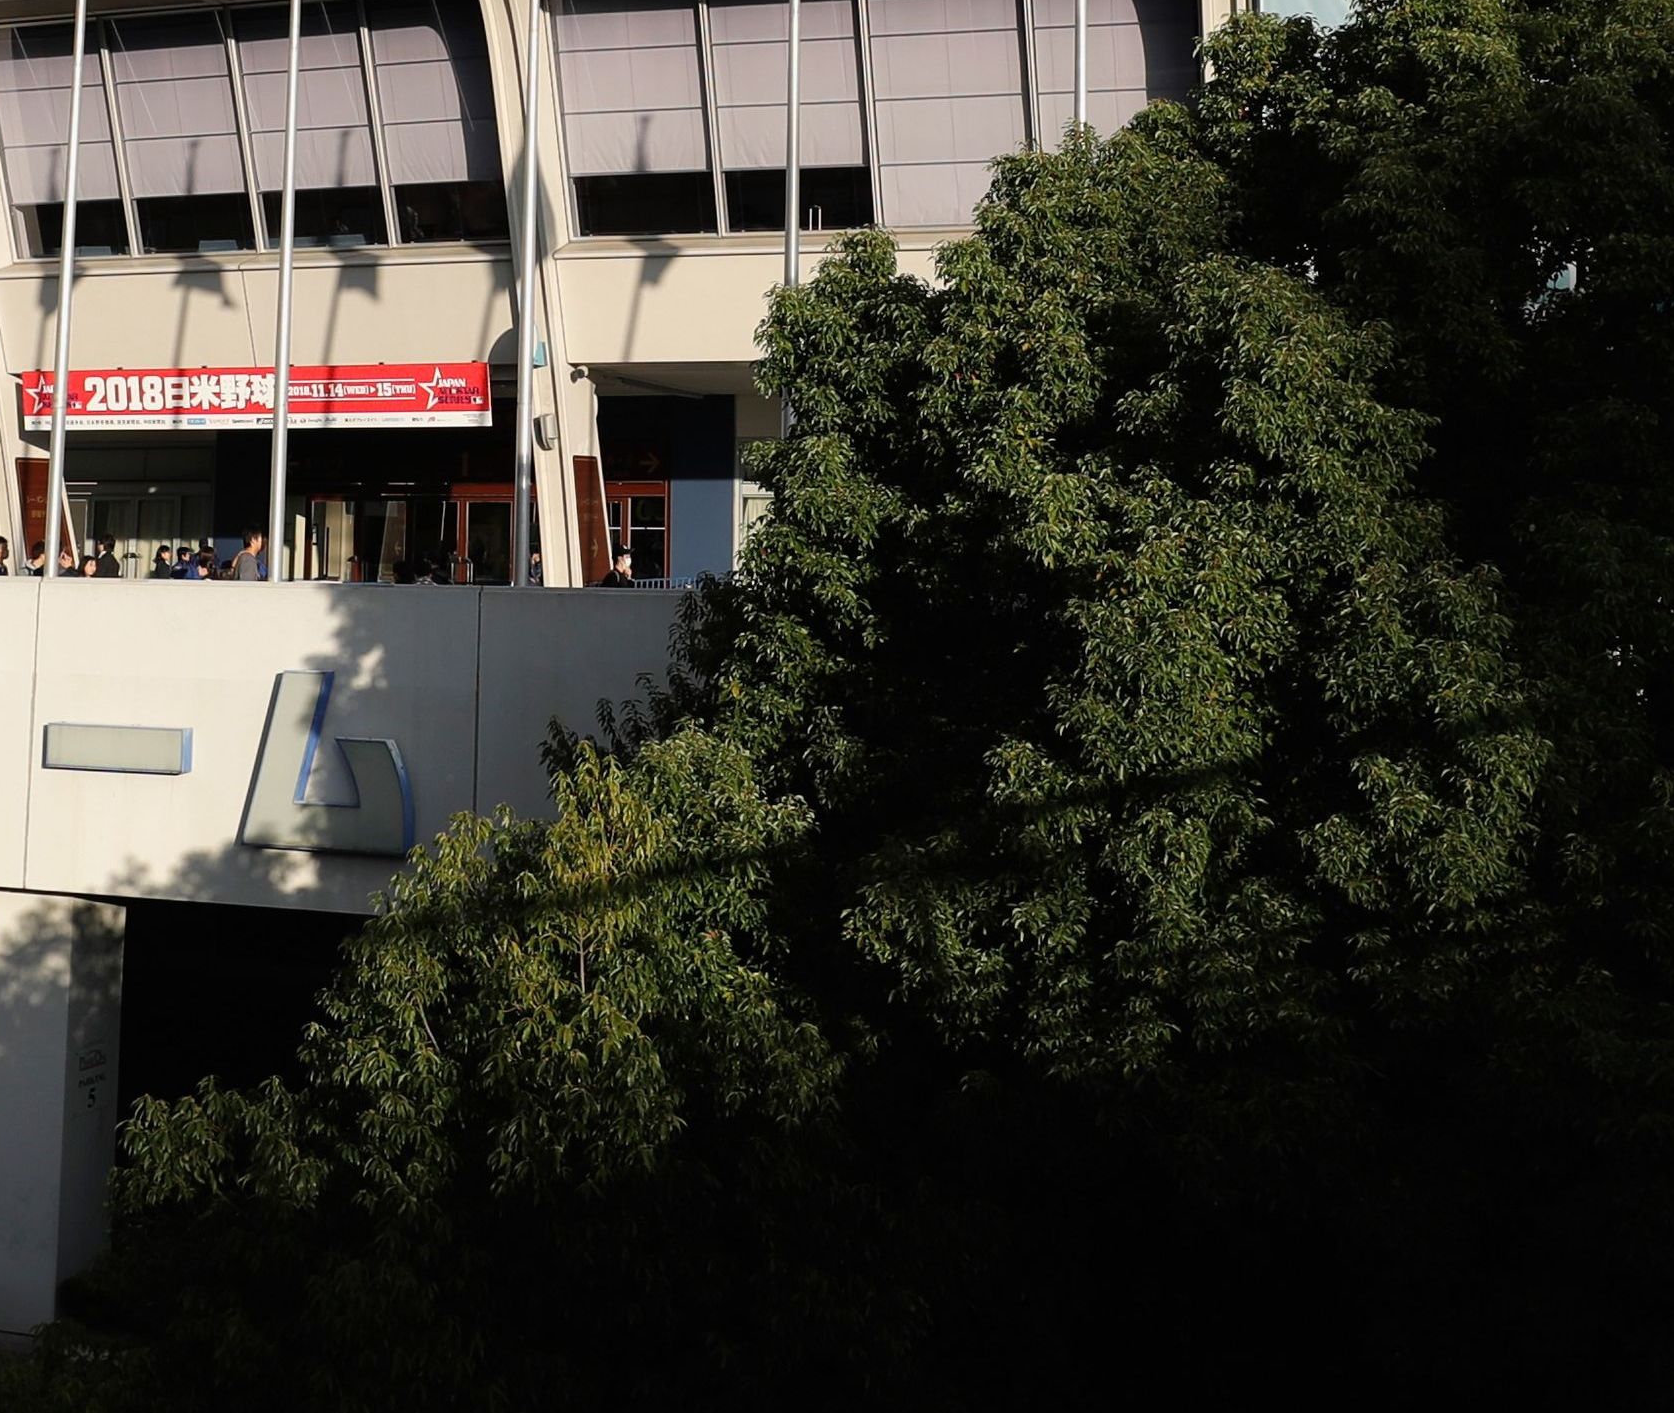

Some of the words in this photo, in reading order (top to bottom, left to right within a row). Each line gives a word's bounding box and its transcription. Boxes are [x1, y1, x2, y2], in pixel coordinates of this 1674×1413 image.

[84, 374, 276, 412] 2018日米野球
[437, 378, 466, 387] JAPAN
